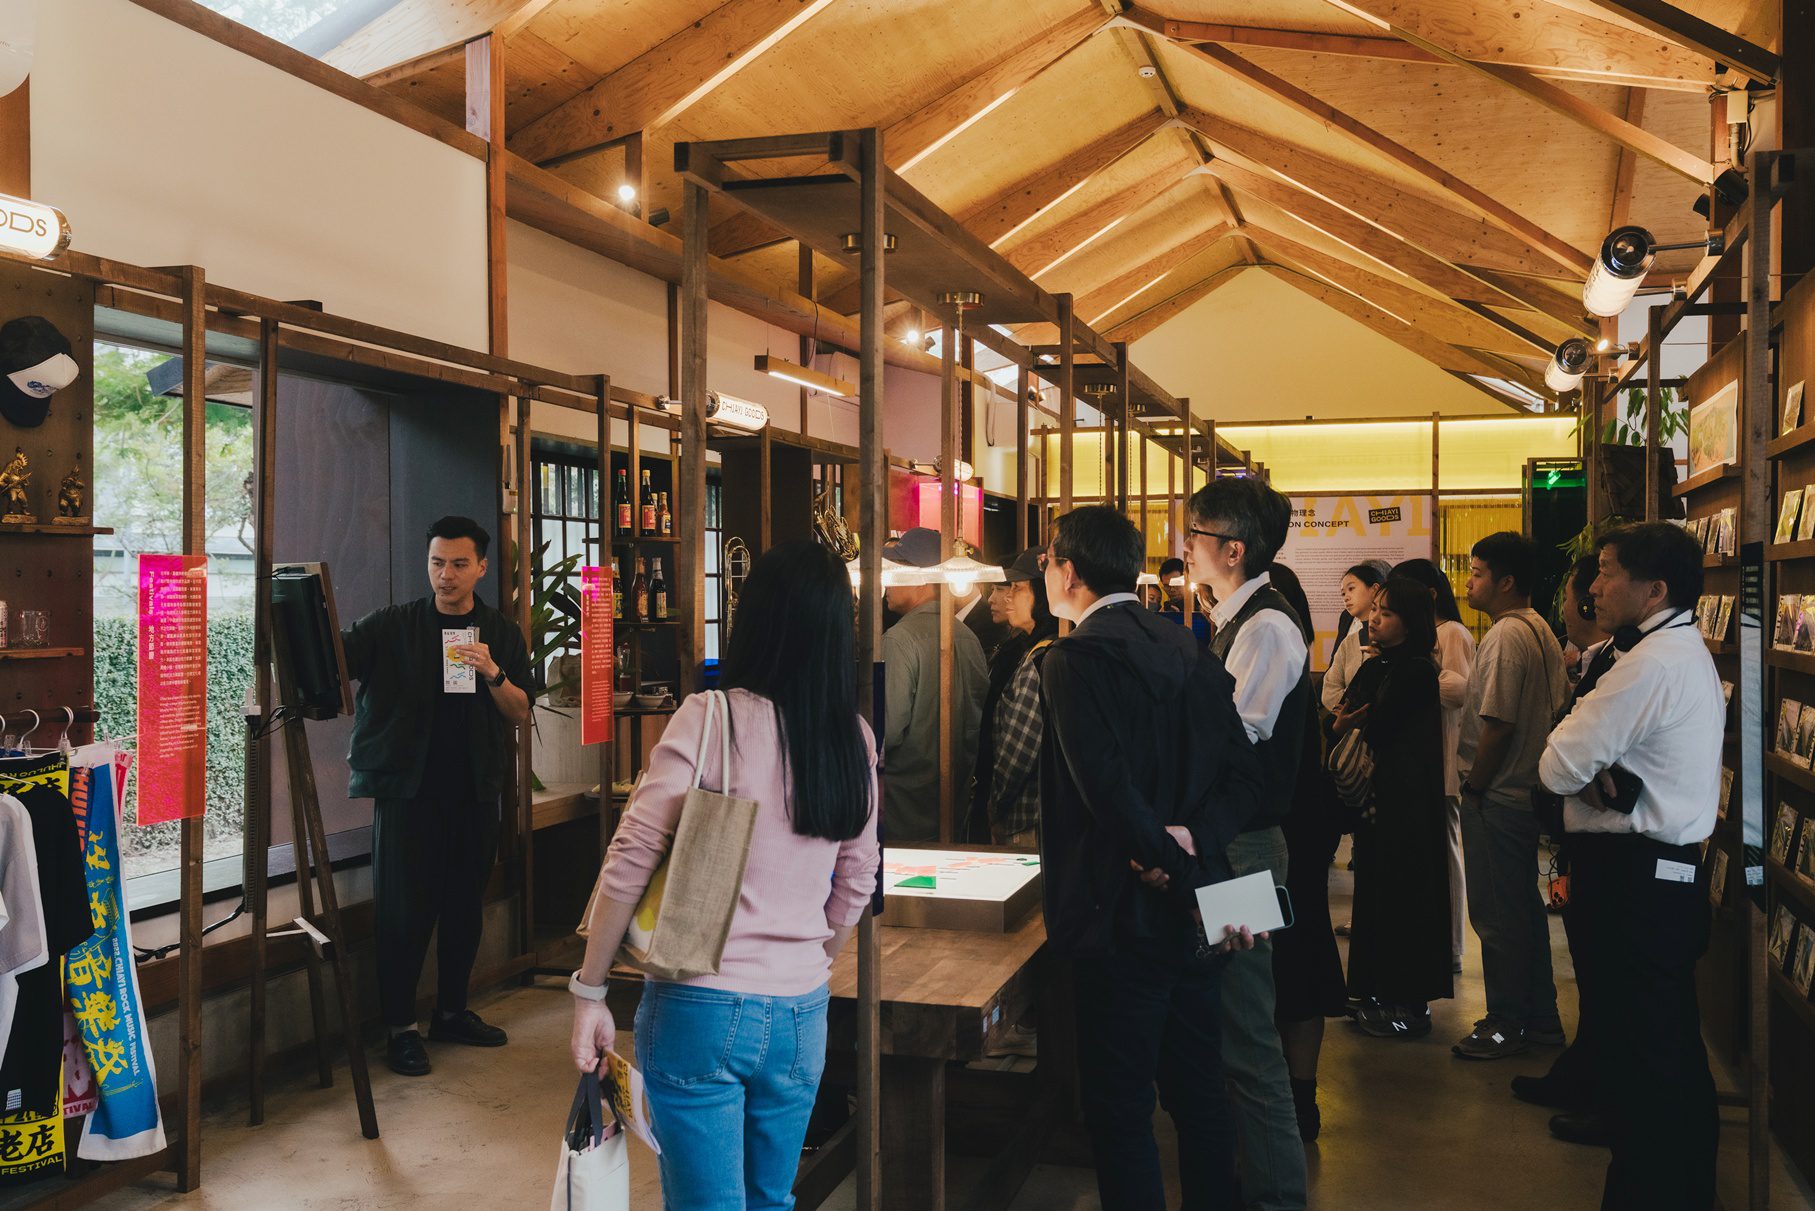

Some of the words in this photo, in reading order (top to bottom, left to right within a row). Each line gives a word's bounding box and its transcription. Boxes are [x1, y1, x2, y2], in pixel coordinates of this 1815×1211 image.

[1304, 520, 1349, 528] CONCEPT
[120, 989, 131, 1013] ROCK
[125, 1014, 136, 1041] MUSIC
[1392, 1021, 1408, 1032] N
[130, 1042, 141, 1076] FESTIVAL
[0, 1124, 55, 1161] 老店
[2, 1155, 63, 1175] FESTIVAL
